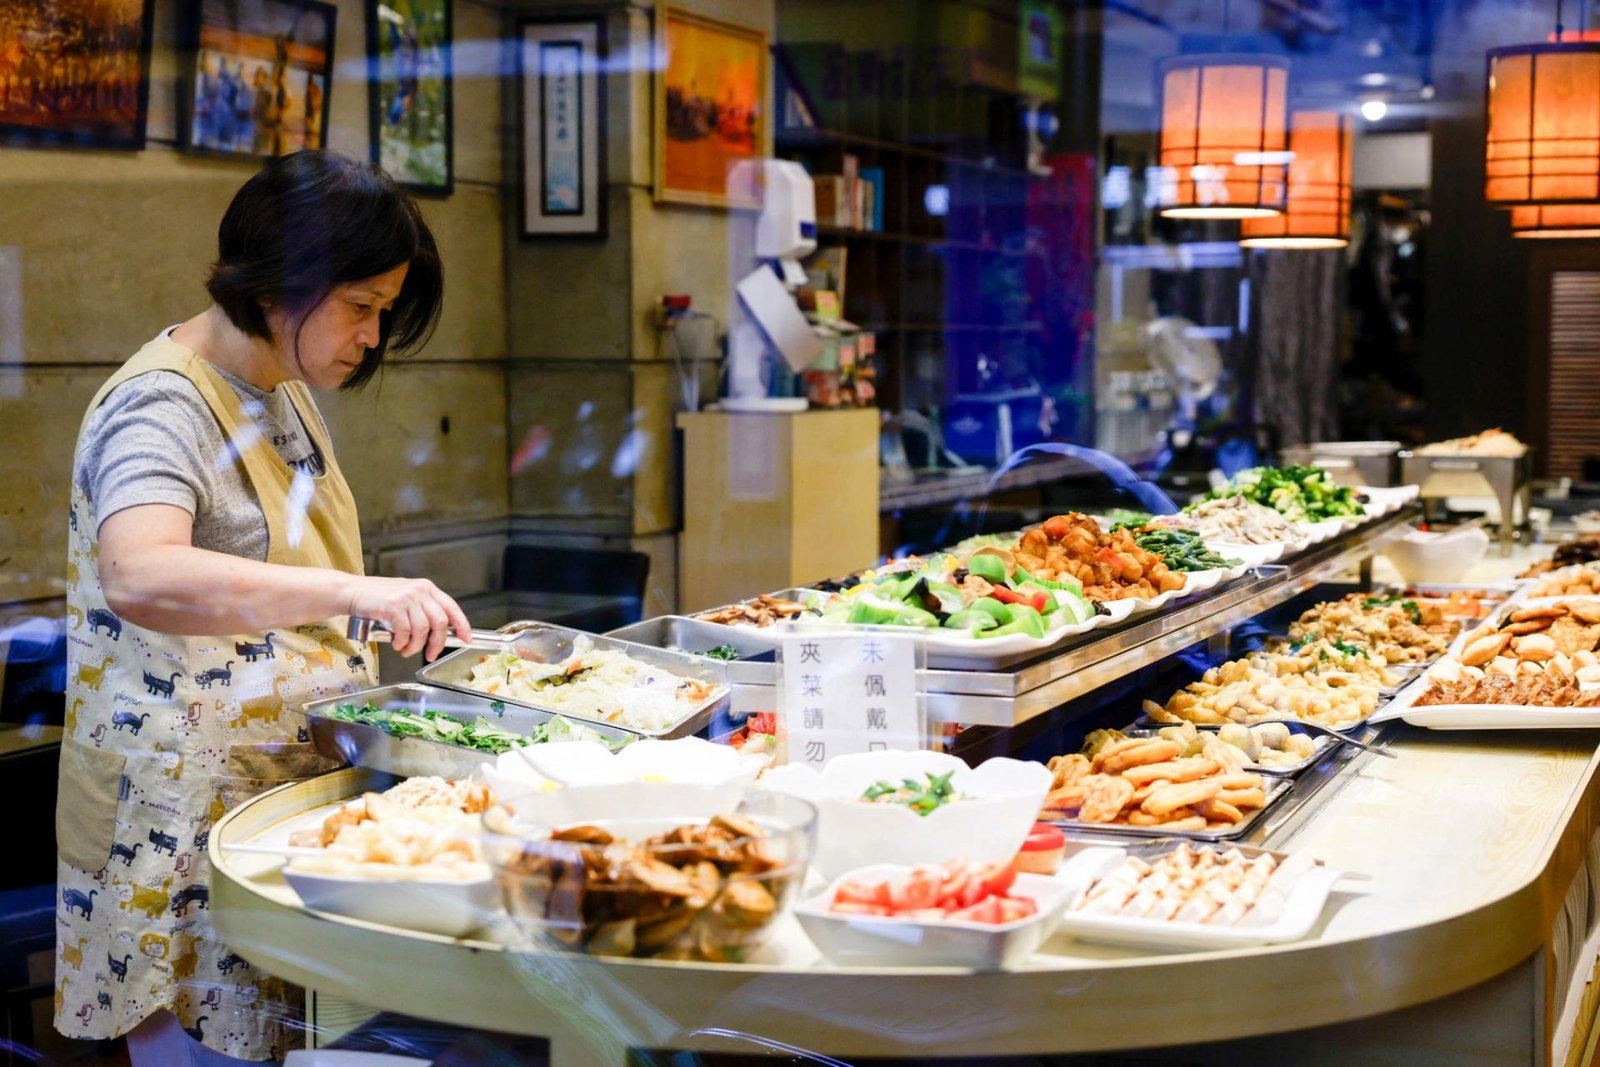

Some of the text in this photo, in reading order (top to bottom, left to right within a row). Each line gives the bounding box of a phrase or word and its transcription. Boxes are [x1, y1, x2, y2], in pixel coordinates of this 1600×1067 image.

[799, 641, 826, 763] 夾菜請勿
[862, 640, 888, 752] 未佩戴口
